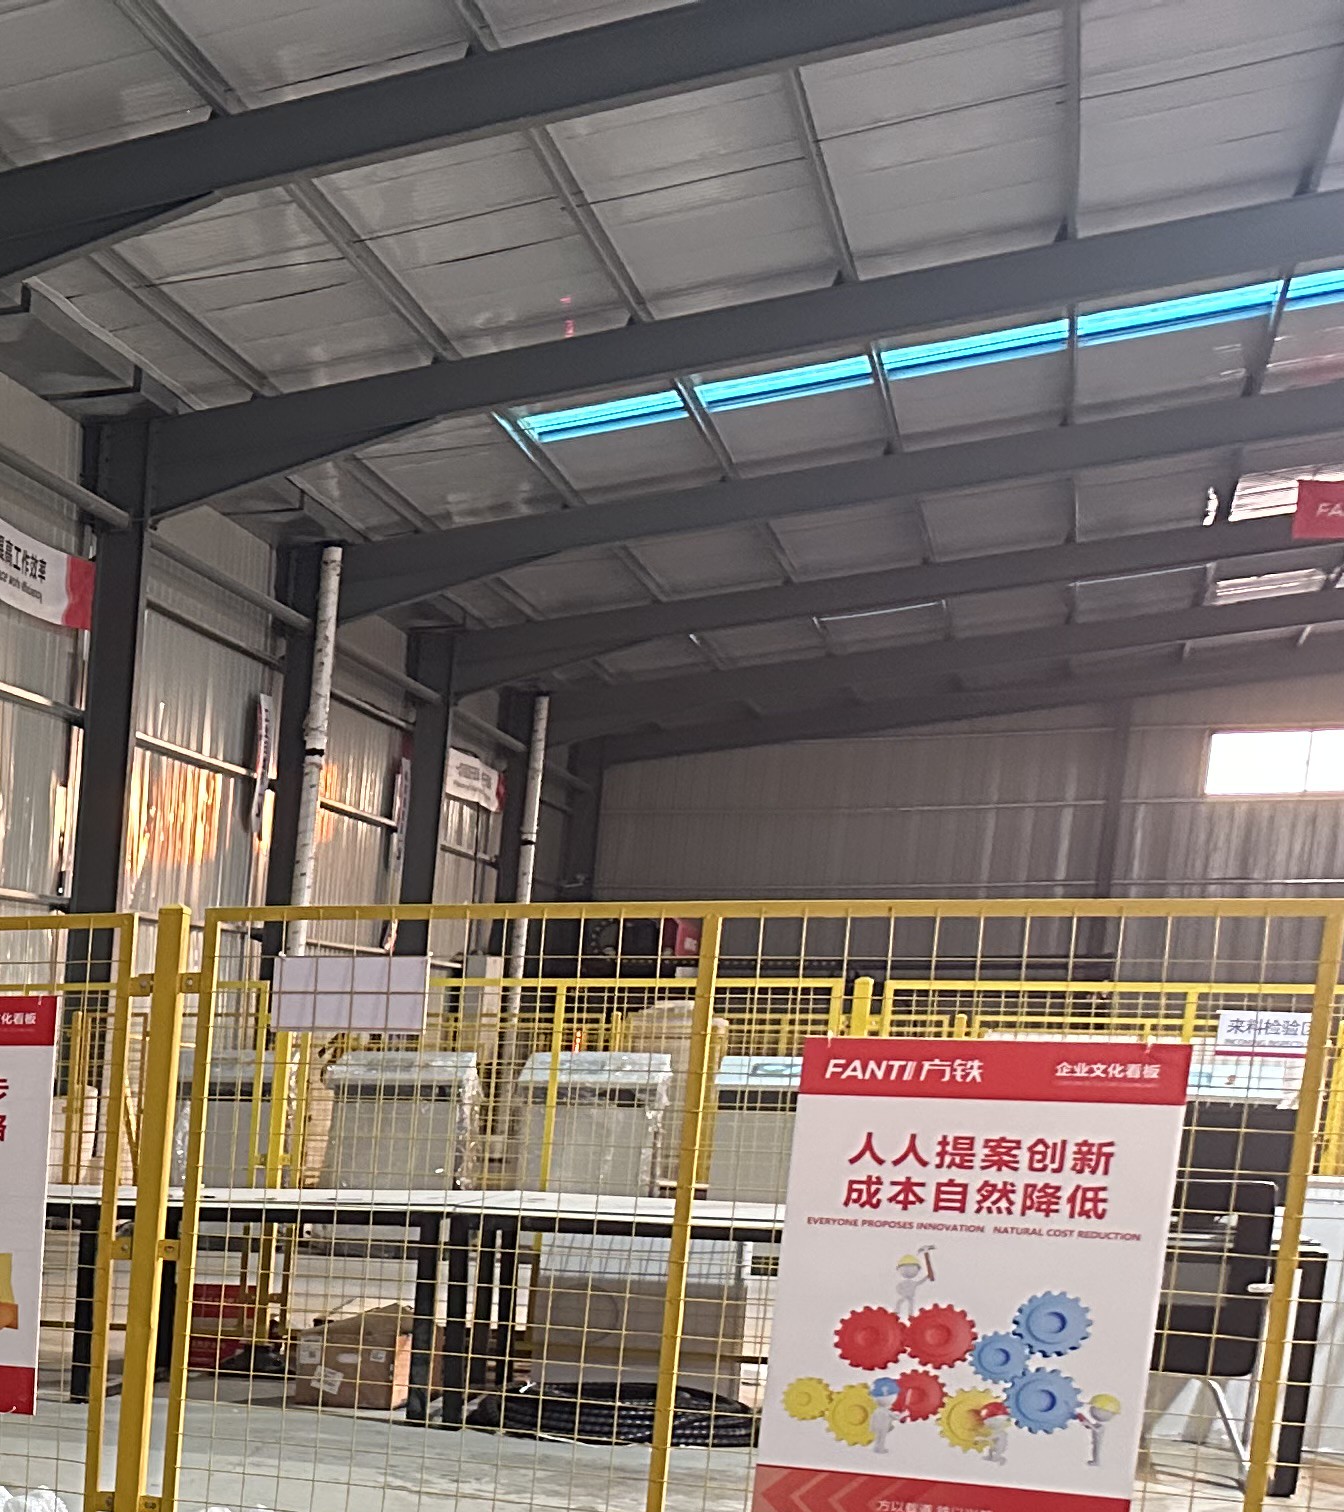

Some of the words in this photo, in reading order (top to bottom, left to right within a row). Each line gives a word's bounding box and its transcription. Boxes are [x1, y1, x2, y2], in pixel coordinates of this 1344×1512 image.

[919, 1059, 984, 1083] 方铁
[1055, 1062, 1160, 1079] 企业文化看板
[848, 1131, 1116, 1176] 人人提案创新
[842, 1177, 1110, 1221] 成本自然降低
[806, 1216, 859, 1227] EVERYONE
[861, 1219, 913, 1230] PROPOSES
[916, 1222, 985, 1233] INNOVATION
[992, 1226, 1044, 1237] NATURAL
[1046, 1229, 1074, 1238] COST
[1077, 1231, 1141, 1242] REDUCTION
